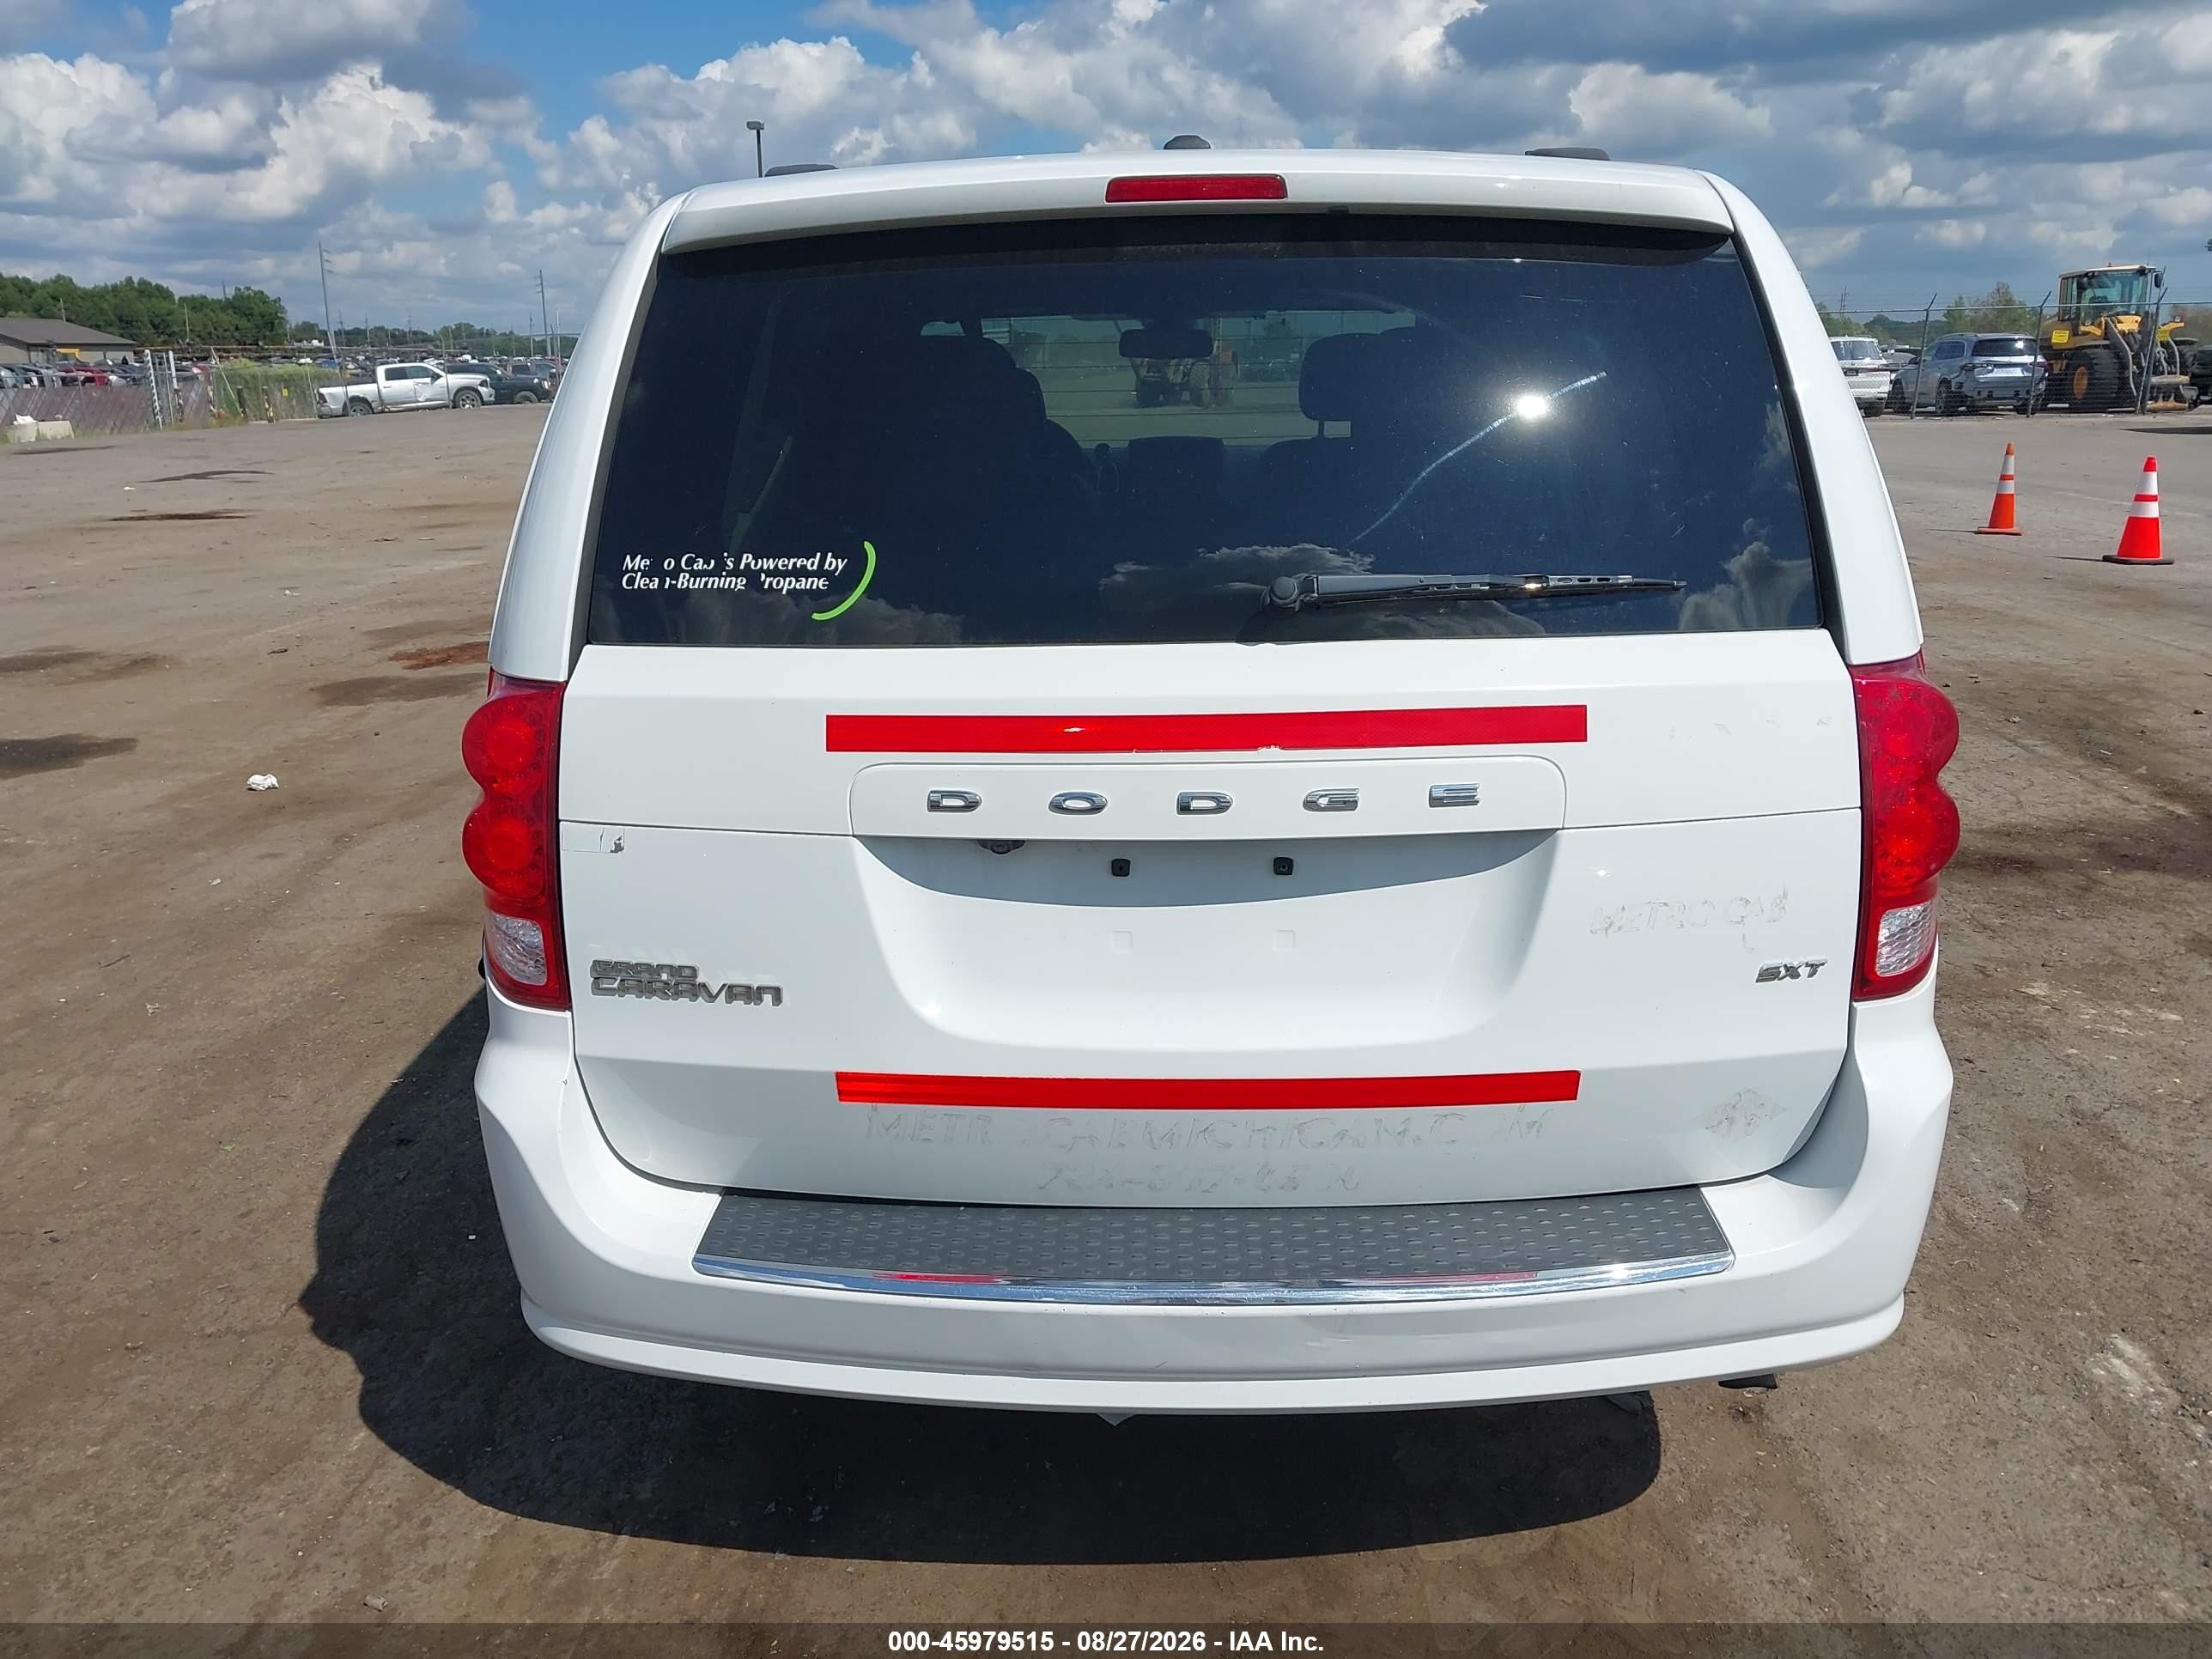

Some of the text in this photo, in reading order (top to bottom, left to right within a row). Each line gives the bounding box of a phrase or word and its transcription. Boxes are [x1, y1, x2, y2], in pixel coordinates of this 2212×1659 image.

[623, 555, 675, 571] Meo
[739, 552, 821, 570] Powered
[823, 552, 848, 576] by
[927, 783, 1480, 816] DODGE
[590, 959, 698, 981] GRAND
[1755, 958, 1827, 983] SXT
[591, 976, 782, 1007] CARAVAN
